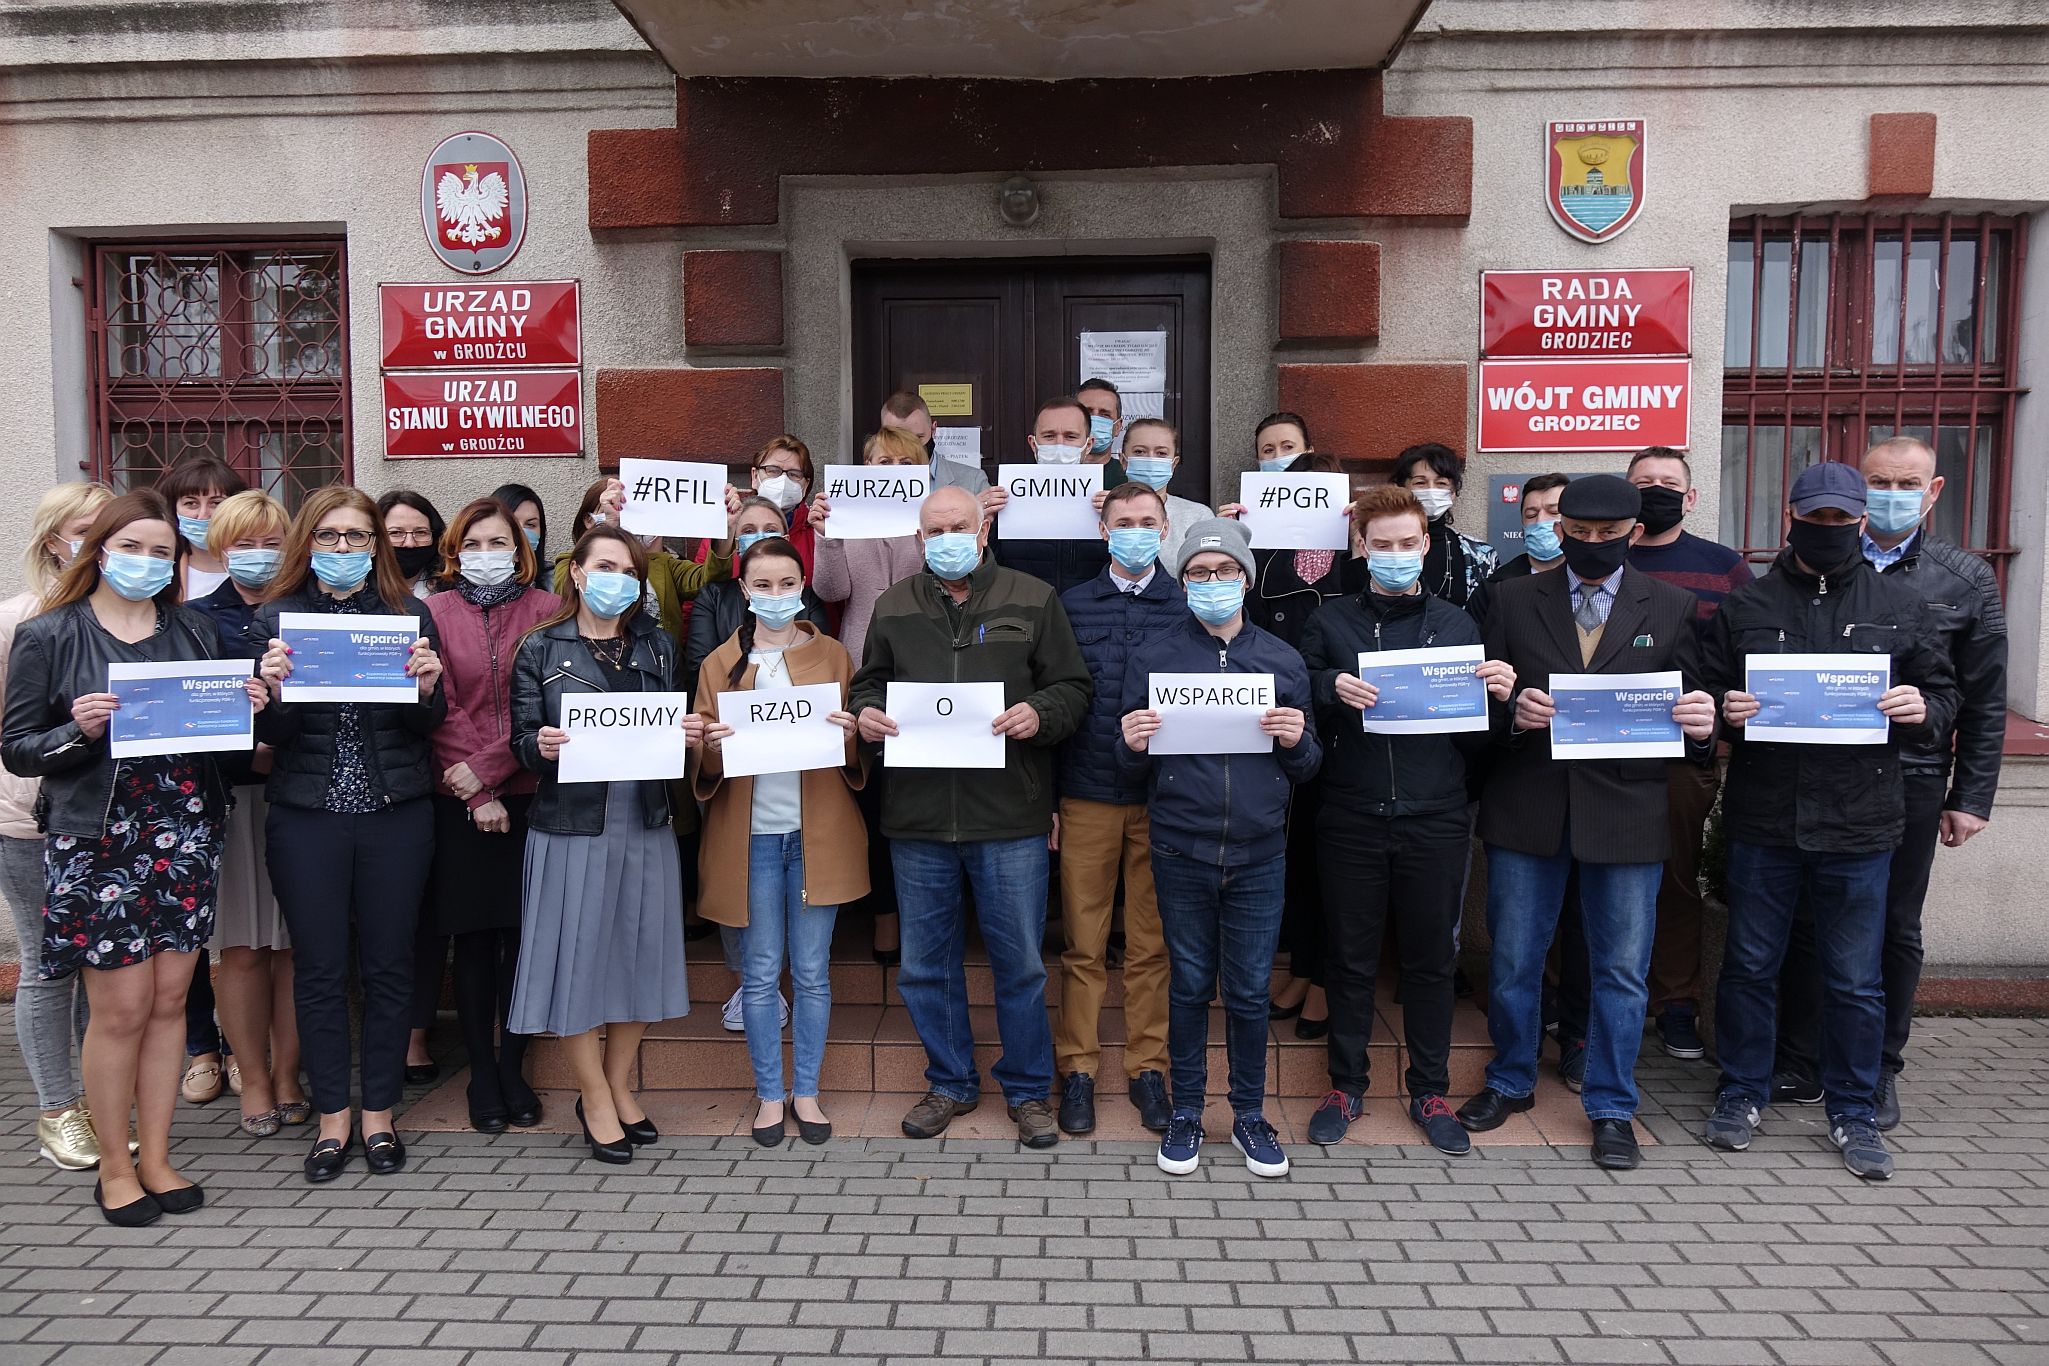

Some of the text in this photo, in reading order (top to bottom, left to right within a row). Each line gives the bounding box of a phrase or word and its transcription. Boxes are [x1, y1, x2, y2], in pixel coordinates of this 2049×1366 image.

[1556, 122, 1636, 132] GRODZIEC
[1542, 278, 1633, 300] RADA
[423, 290, 531, 314] URZĄD
[1533, 304, 1642, 328] GMINY
[425, 315, 528, 339] GMINY
[1541, 331, 1632, 349] GRODZIEC
[433, 341, 527, 360] w GRODŹCU
[443, 380, 517, 404] URZĄD
[1487, 381, 1684, 410] WÓJT GMINY
[389, 405, 575, 430] STANU CYWILNEGO
[1528, 414, 1641, 432] GRODZIEC
[441, 434, 525, 451] w GRODŹCU
[633, 476, 716, 505] #RFIL
[829, 479, 924, 503] #URZĄD
[1010, 478, 1092, 498] GMINY
[1259, 486, 1329, 509] #PGR
[350, 633, 410, 646] Wsparcie
[1421, 662, 1476, 679] Wsparcie
[1816, 672, 1879, 687] Wsparcie
[182, 677, 243, 692] Wsparcie
[936, 697, 953, 716] O
[1155, 687, 1268, 706] WSPARCIE
[1615, 690, 1674, 704] Wsparcie
[568, 706, 679, 728] PROSIMY
[750, 700, 812, 724] RZĄD
